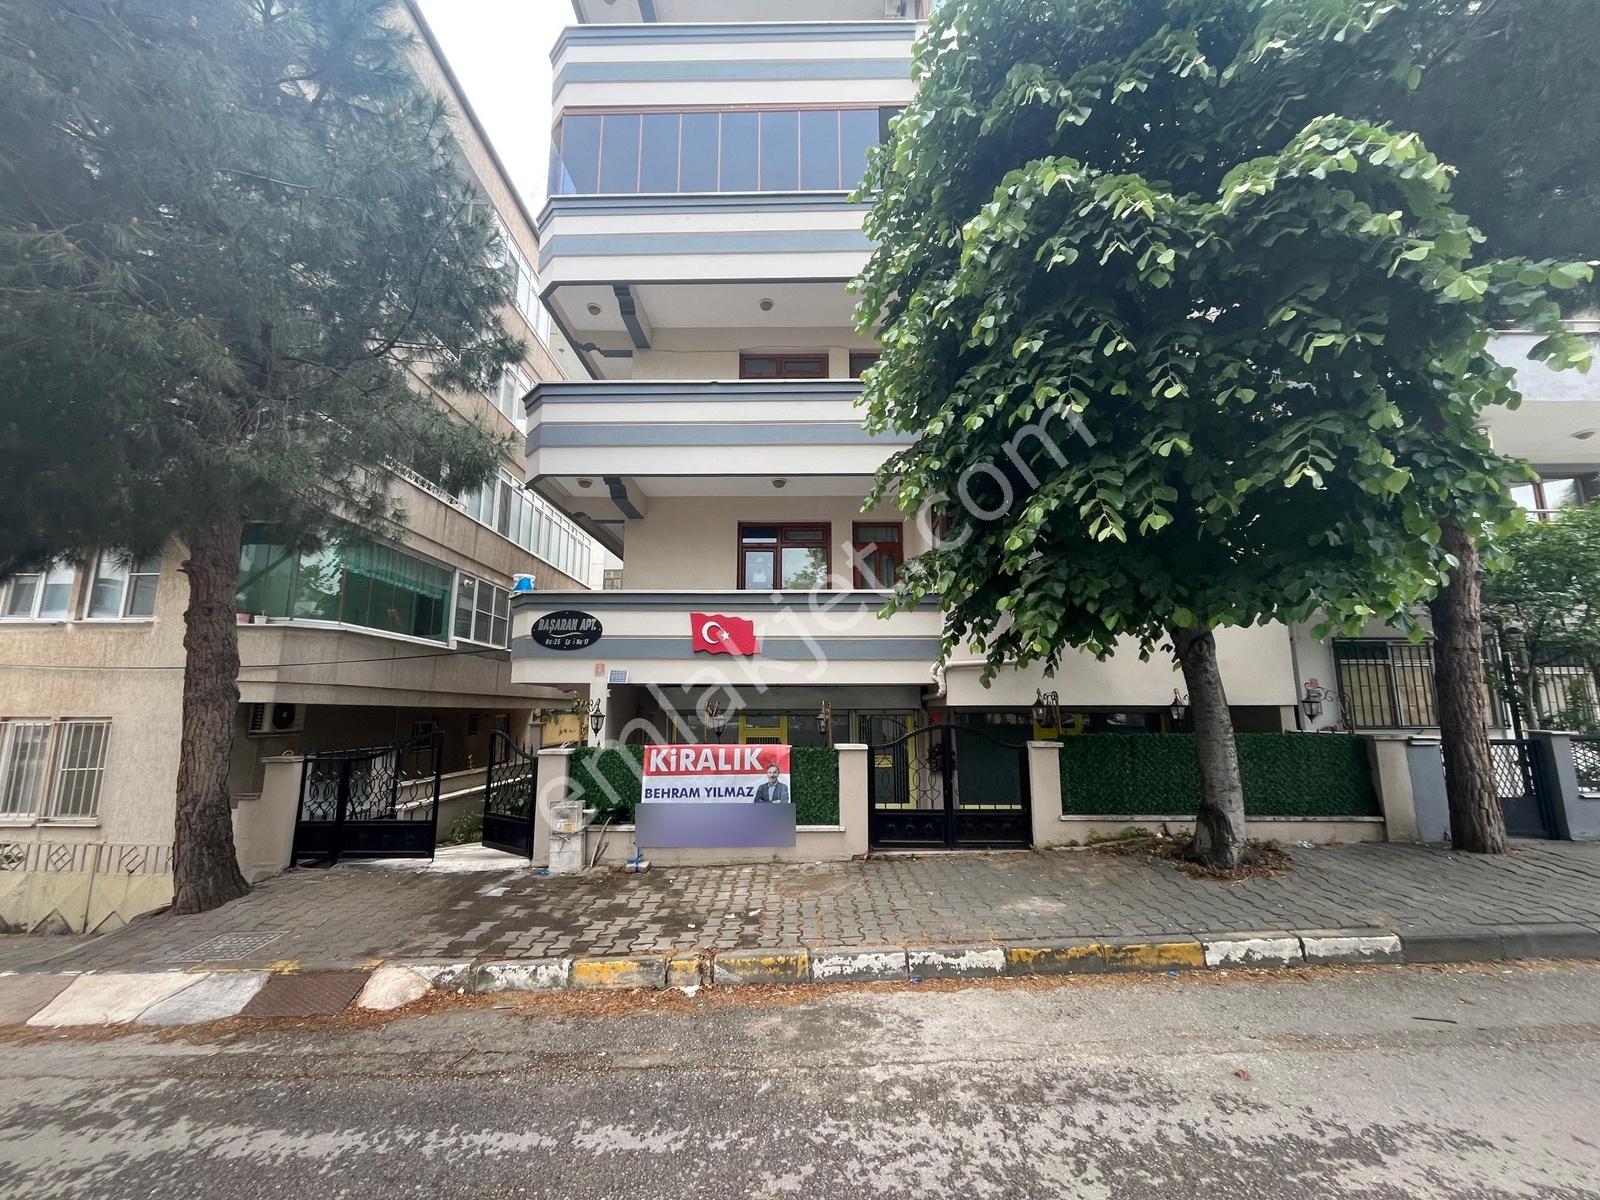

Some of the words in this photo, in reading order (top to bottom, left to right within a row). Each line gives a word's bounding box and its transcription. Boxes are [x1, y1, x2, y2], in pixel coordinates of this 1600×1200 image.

[538, 618, 578, 633] BAŞARAN
[580, 618, 597, 630] APT.
[644, 787, 700, 799] BEHRAM
[705, 786, 755, 798] YILMAZ
